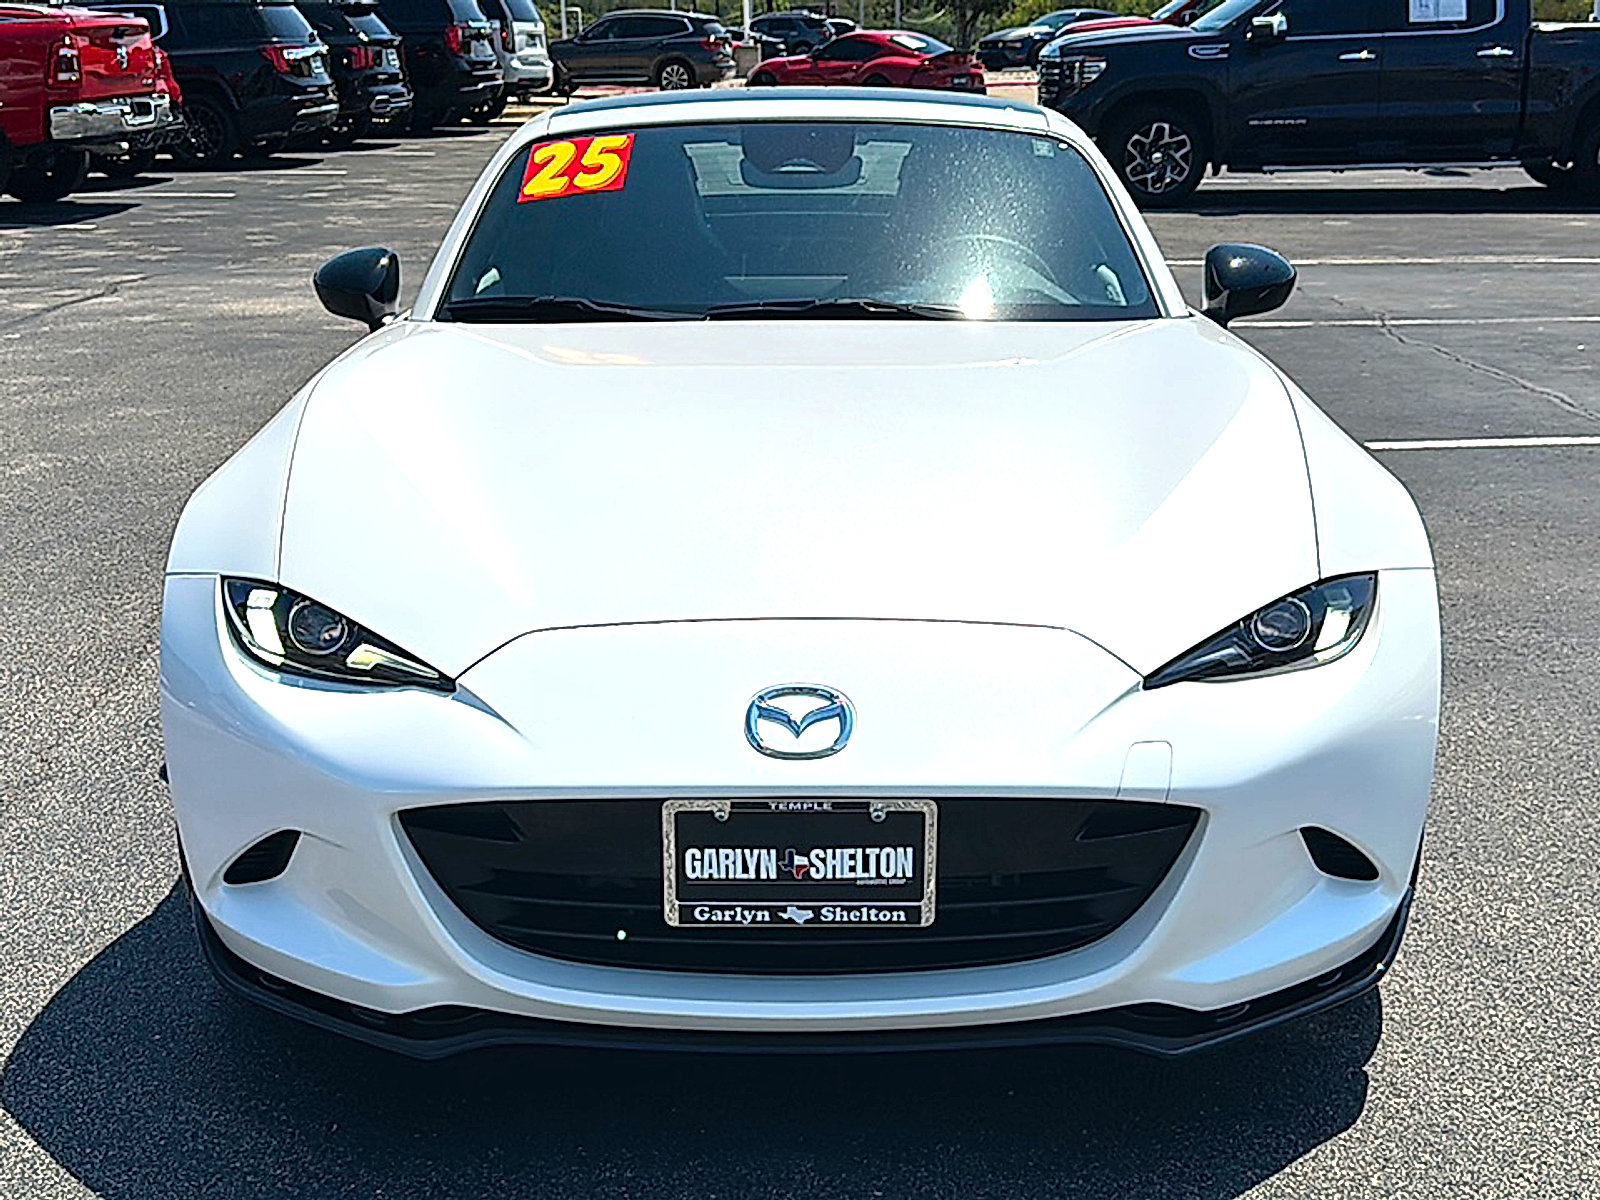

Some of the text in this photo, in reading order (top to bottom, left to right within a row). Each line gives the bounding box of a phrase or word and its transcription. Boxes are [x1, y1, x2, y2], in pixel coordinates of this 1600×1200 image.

[523, 135, 630, 197] 25
[768, 801, 832, 811] TEMPLE
[685, 847, 913, 879] GARLYN SHELTON
[693, 906, 906, 925] Garlyn Shelton
